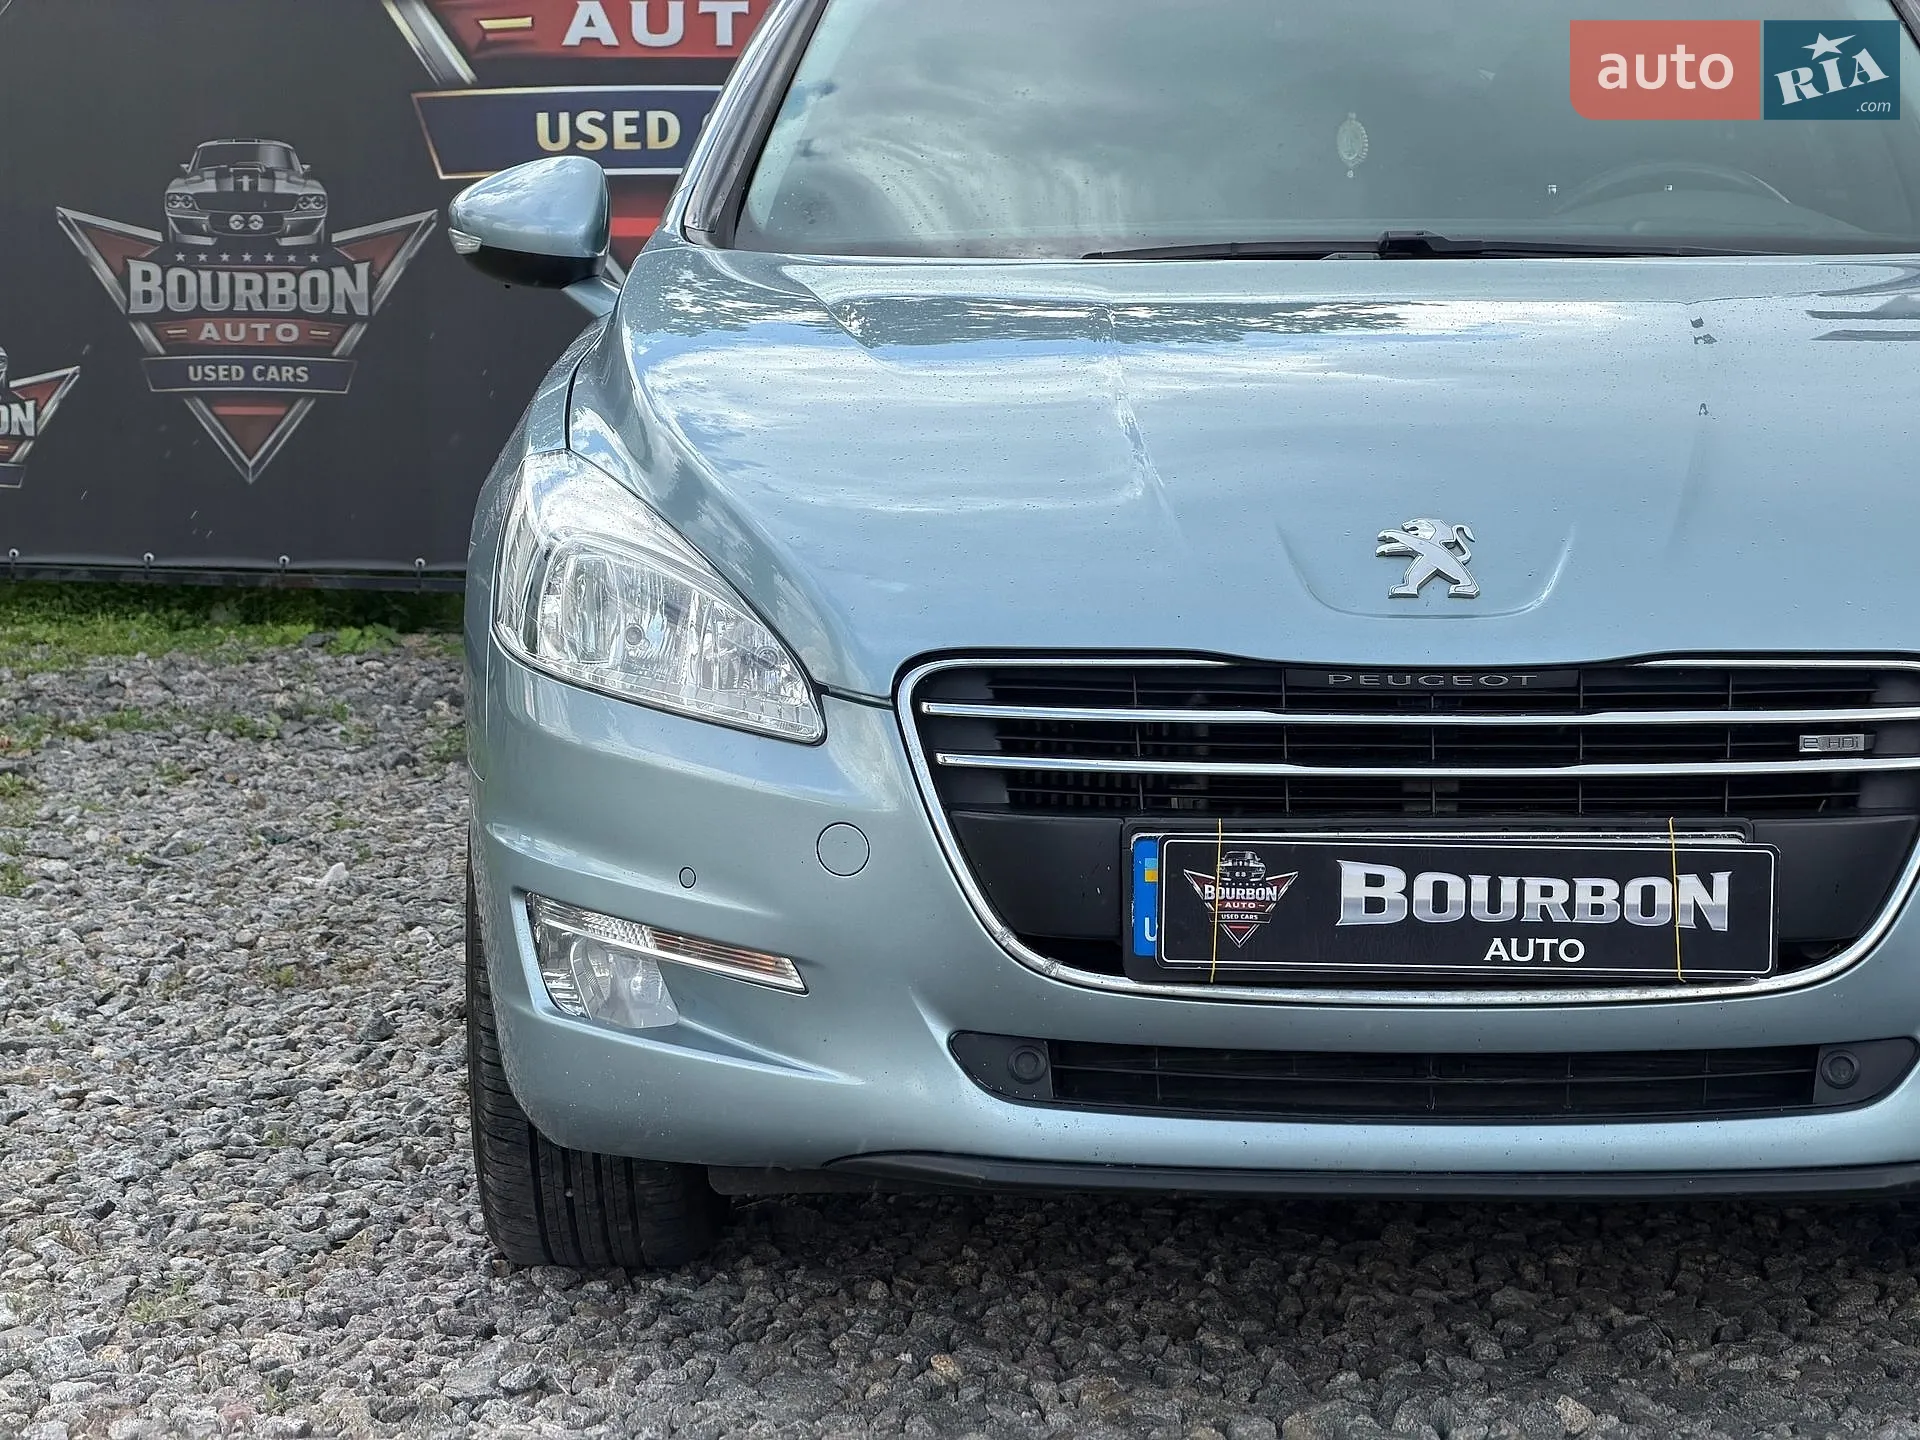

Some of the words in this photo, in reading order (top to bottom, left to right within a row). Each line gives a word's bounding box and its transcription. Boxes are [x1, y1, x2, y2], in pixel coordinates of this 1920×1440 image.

[536, 110, 681, 151] USED
[127, 258, 371, 316] BOURBON
[198, 322, 300, 343] AUTO
[188, 365, 245, 382] USED
[252, 366, 309, 383] CARS
[1328, 674, 1537, 687] PEUGEOT
[1203, 884, 1278, 901] BOURBON
[1336, 859, 1733, 932] BOURBON
[1224, 901, 1256, 909] AUTO
[1483, 937, 1585, 963] AUTO
